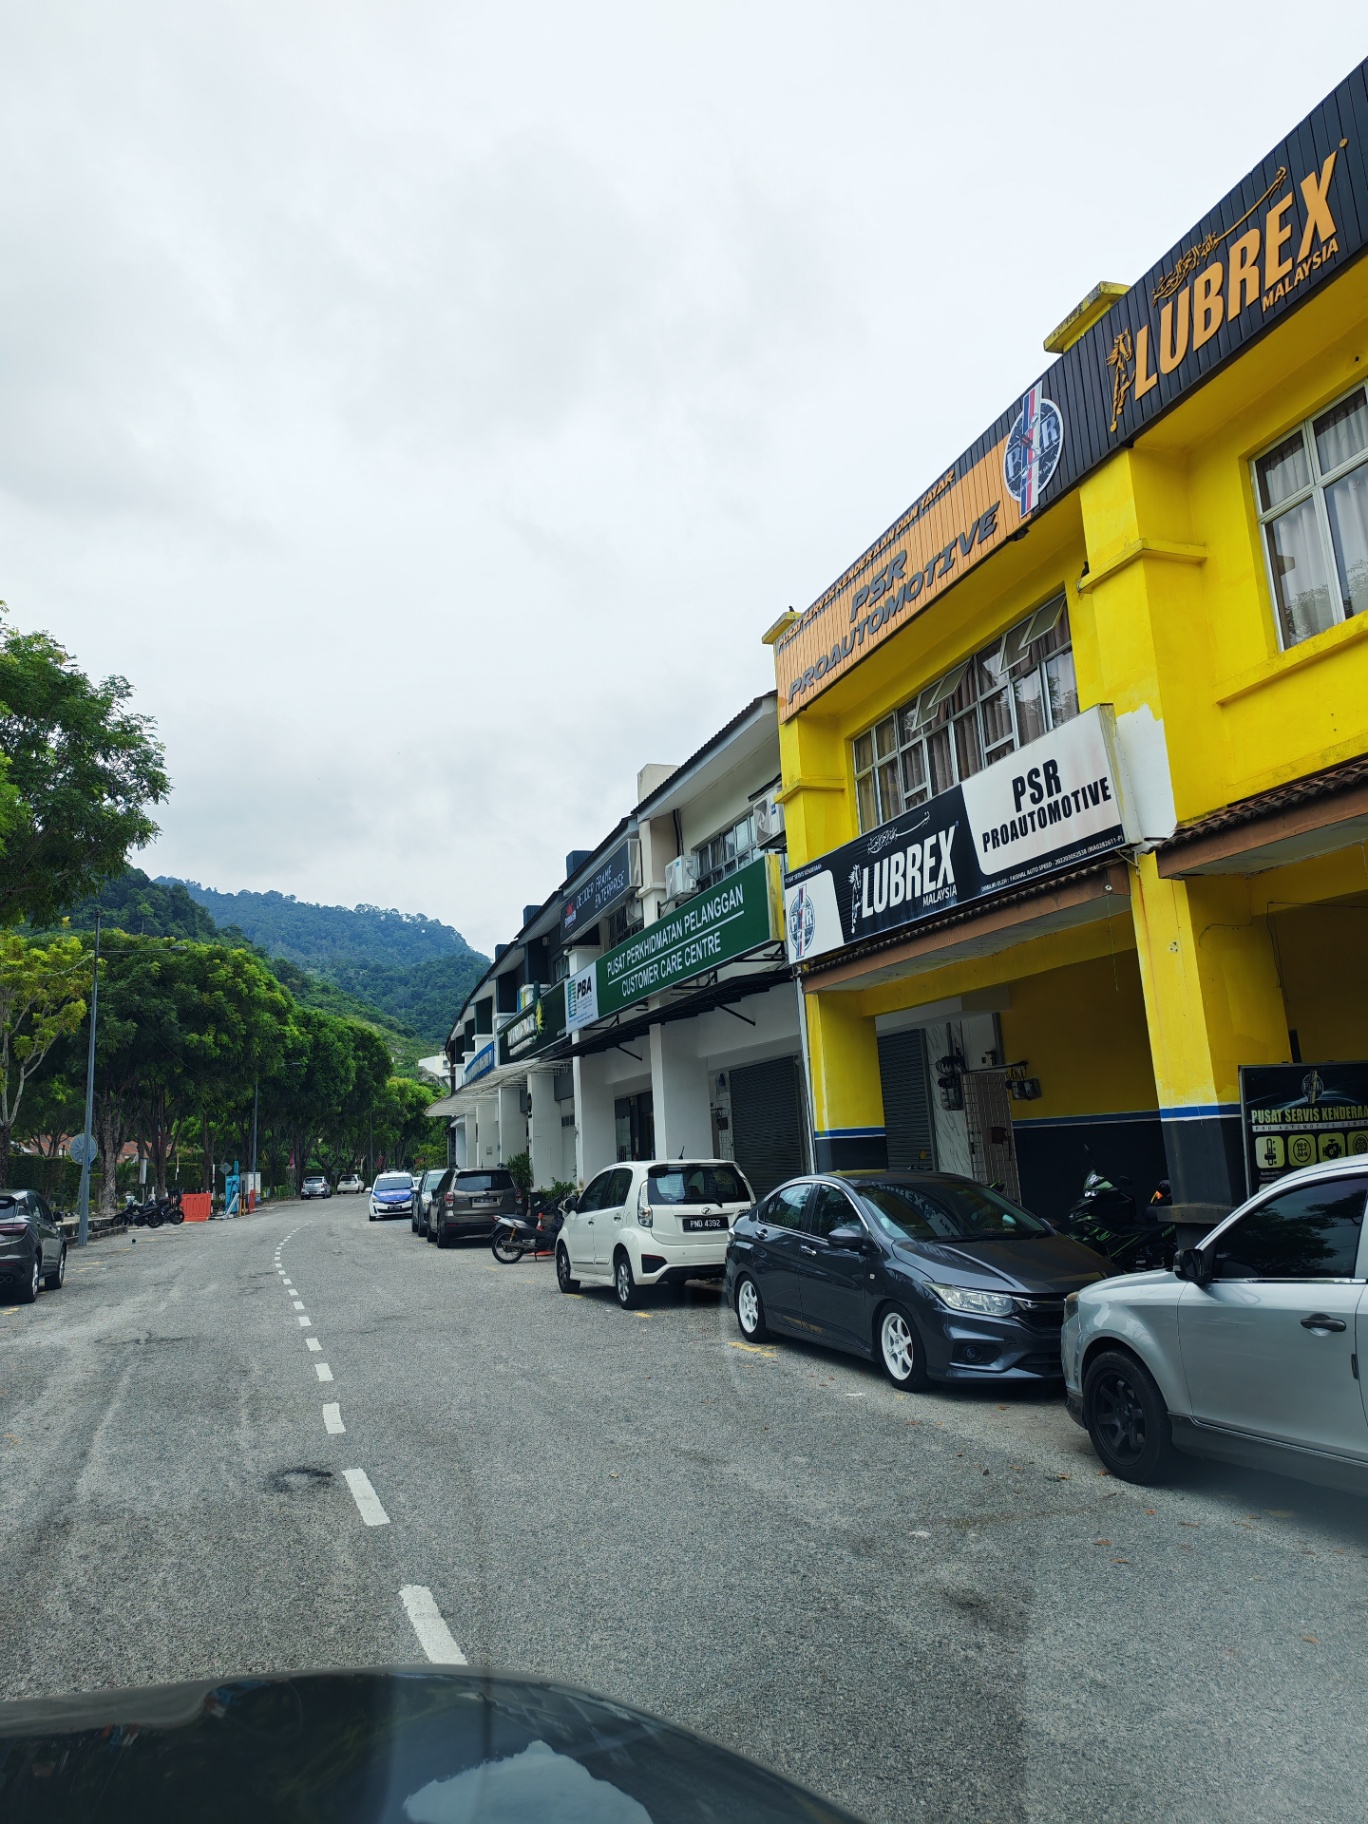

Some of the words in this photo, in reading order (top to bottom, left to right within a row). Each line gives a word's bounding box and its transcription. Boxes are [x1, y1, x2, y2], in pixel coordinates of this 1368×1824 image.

[1134, 150, 1337, 401] LUBREX
[1262, 237, 1338, 313] MALAYSIA
[804, 588, 836, 626] SERVIS
[836, 528, 896, 593] KENDERAAN
[896, 504, 919, 536] DAN
[920, 470, 954, 511] TAYAR
[788, 500, 1001, 705] PROAUTOMOTIVE
[850, 549, 908, 623] PSR
[982, 777, 1112, 853] PROAUTOMOTIVE
[1012, 759, 1062, 813] PSR
[594, 869, 625, 909] ENTERPRISE
[862, 824, 957, 919] LUBREX
[922, 884, 958, 907] MALAYSIA
[1026, 866, 1039, 876] AUTO
[1038, 861, 1053, 871] SPEED
[607, 955, 625, 978] PUSAT
[626, 919, 683, 966] PERKHIDMATAN
[684, 883, 744, 935] PELANGGAN
[621, 963, 660, 997] CUSTOMER
[660, 951, 683, 978] CARE
[684, 931, 722, 967] CENTRE
[576, 975, 592, 1000] PBA
[1251, 1108, 1283, 1124] PUSAT
[1284, 1106, 1320, 1122] SERVIS
[704, 1219, 721, 1227] 4392
